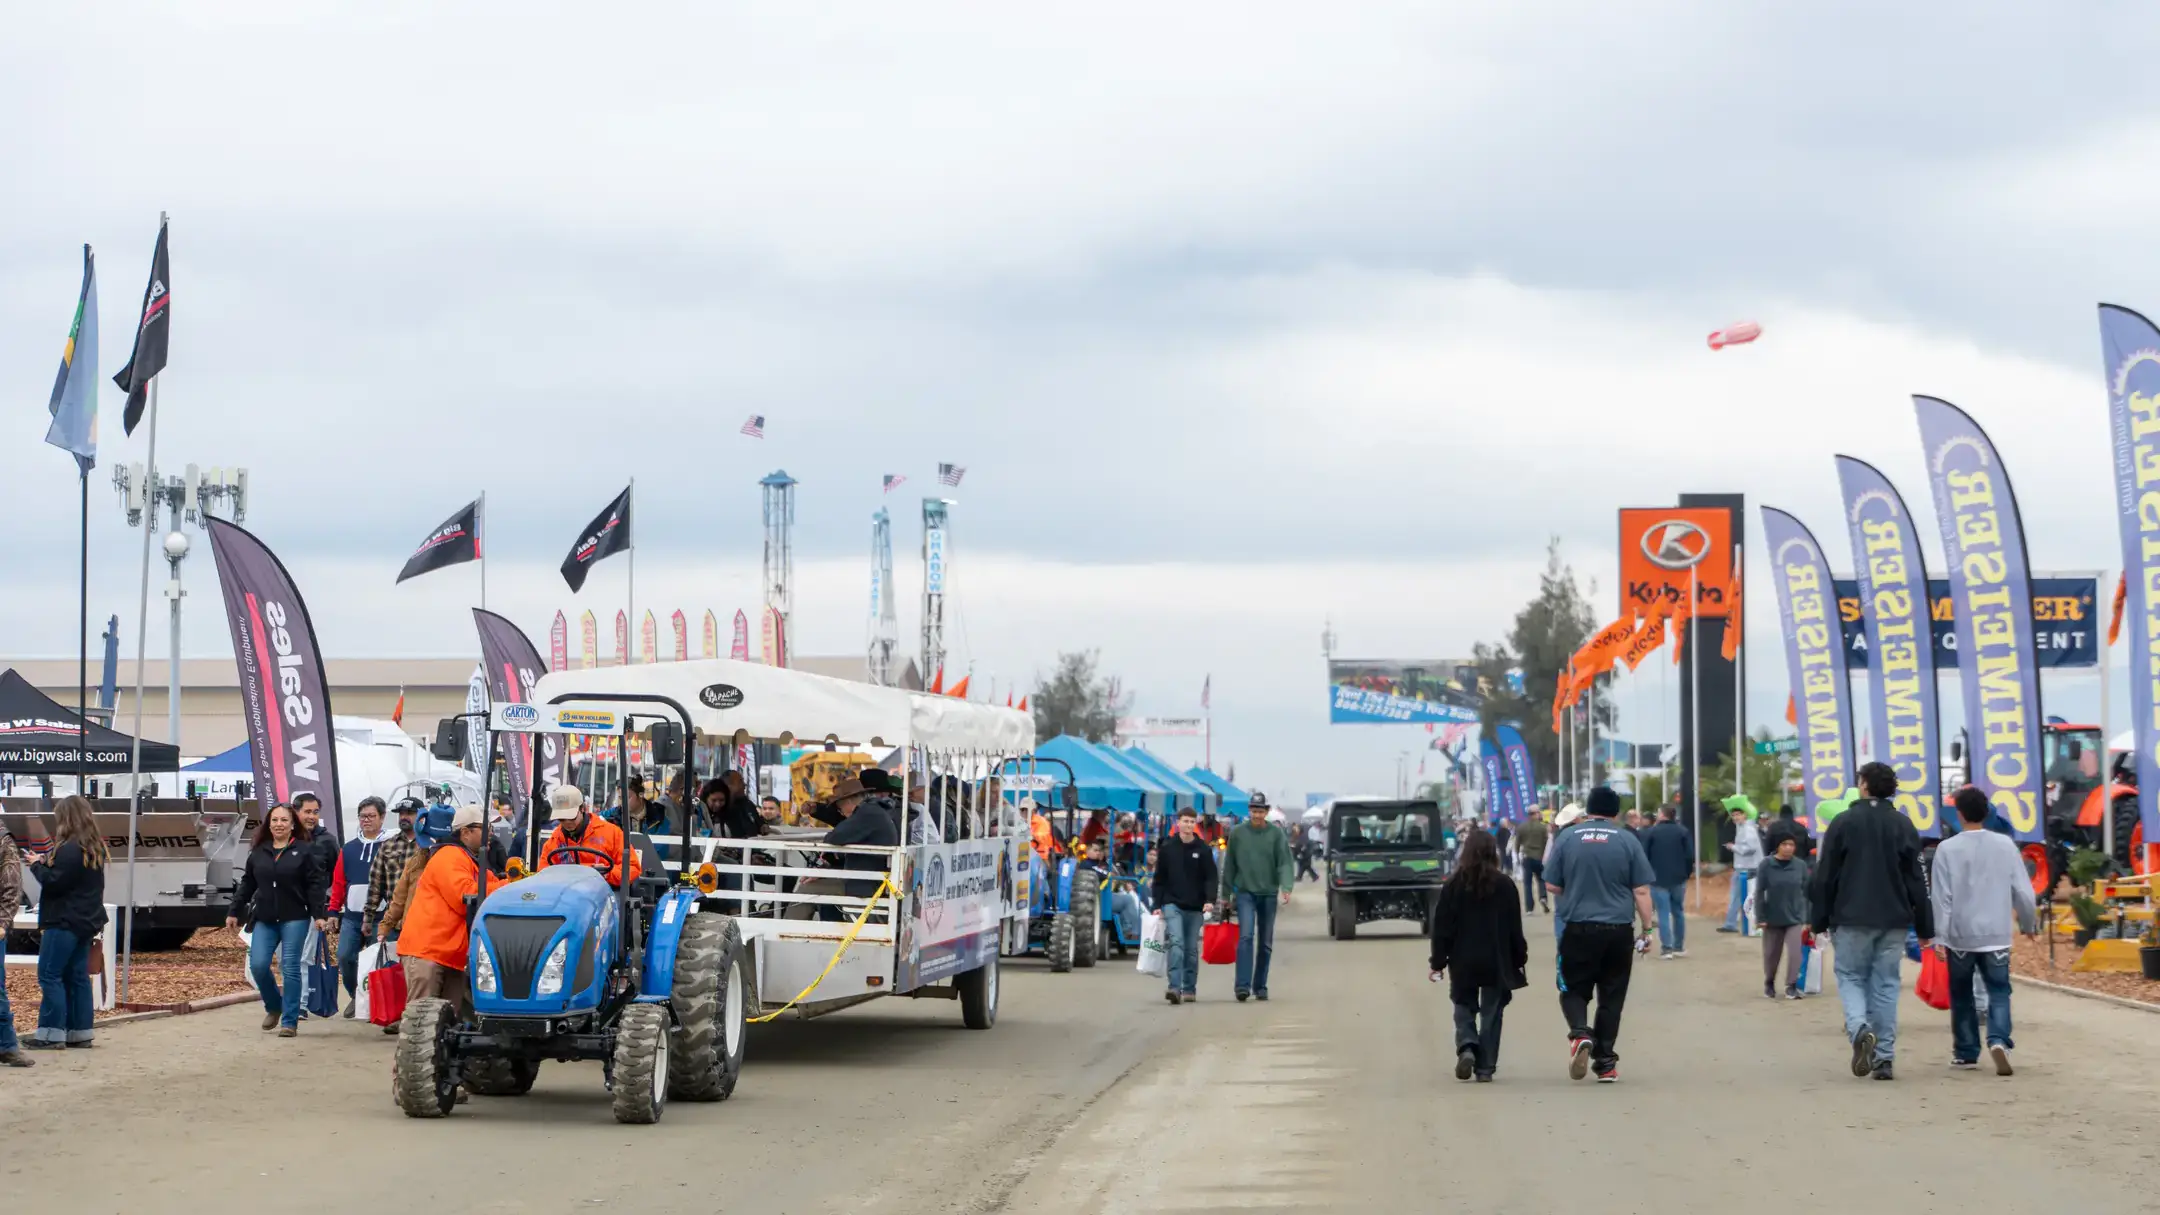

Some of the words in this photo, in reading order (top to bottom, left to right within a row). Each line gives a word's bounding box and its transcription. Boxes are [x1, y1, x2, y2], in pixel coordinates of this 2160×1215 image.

[1629, 581, 1723, 604] Kubta
[505, 706, 535, 718] GARTON
[12, 719, 33, 728] W
